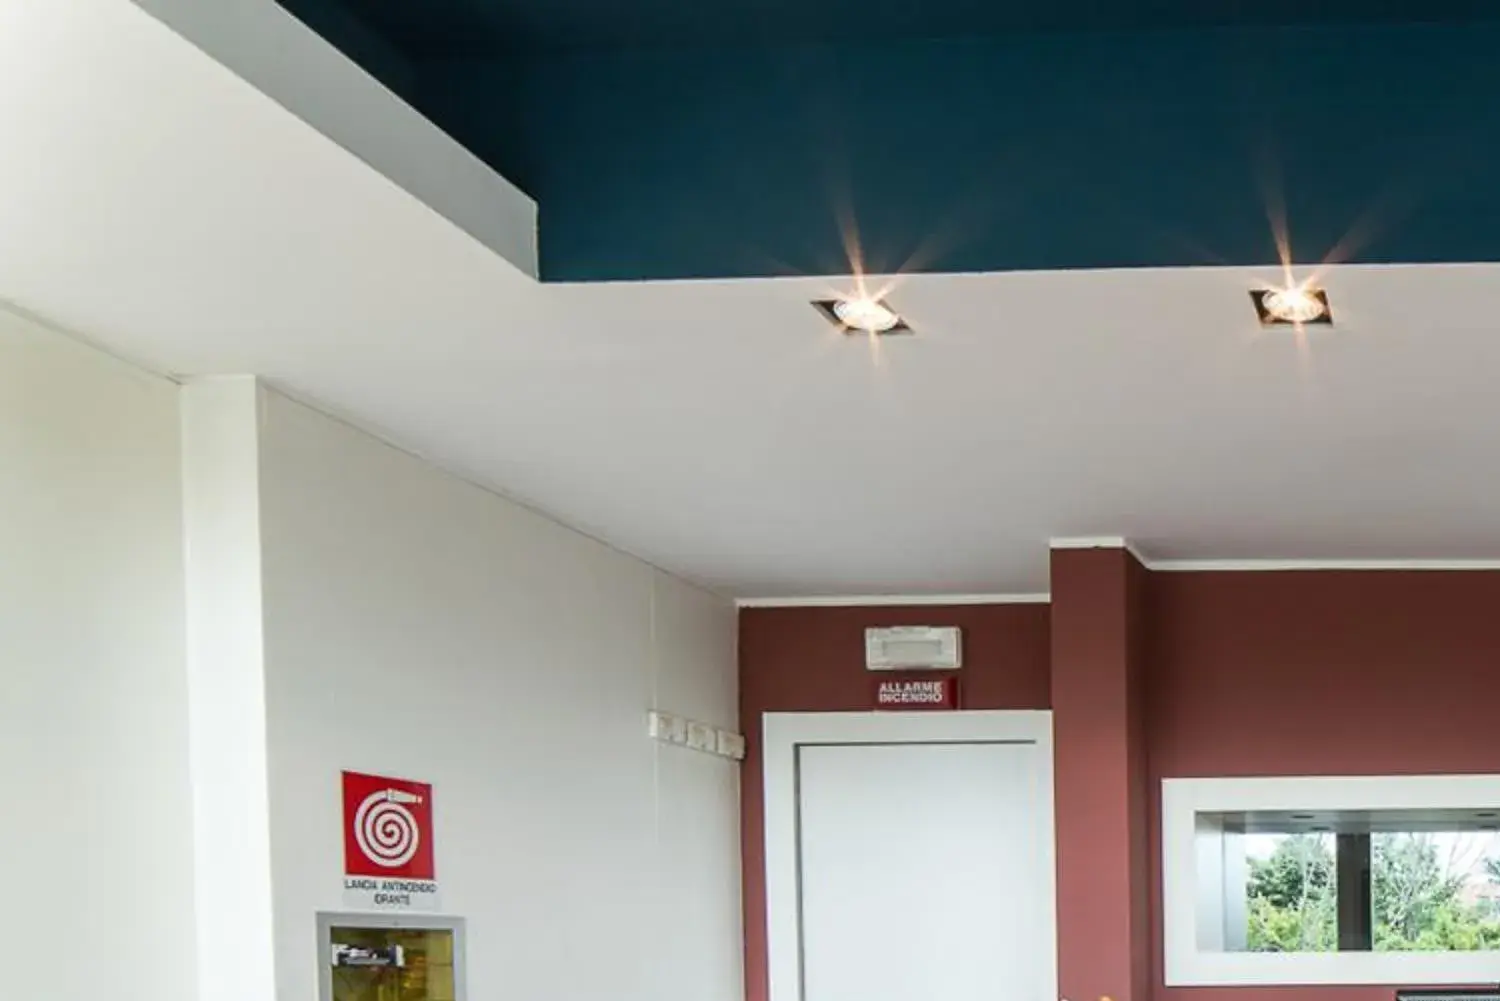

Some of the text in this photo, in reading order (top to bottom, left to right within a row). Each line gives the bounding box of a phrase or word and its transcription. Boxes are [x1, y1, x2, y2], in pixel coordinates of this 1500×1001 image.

[880, 681, 942, 692] ALLARME
[879, 692, 943, 703] INCENDIO
[344, 880, 437, 893] LANCIA ANTINCENDIO
[374, 893, 410, 905] IDRANTE
